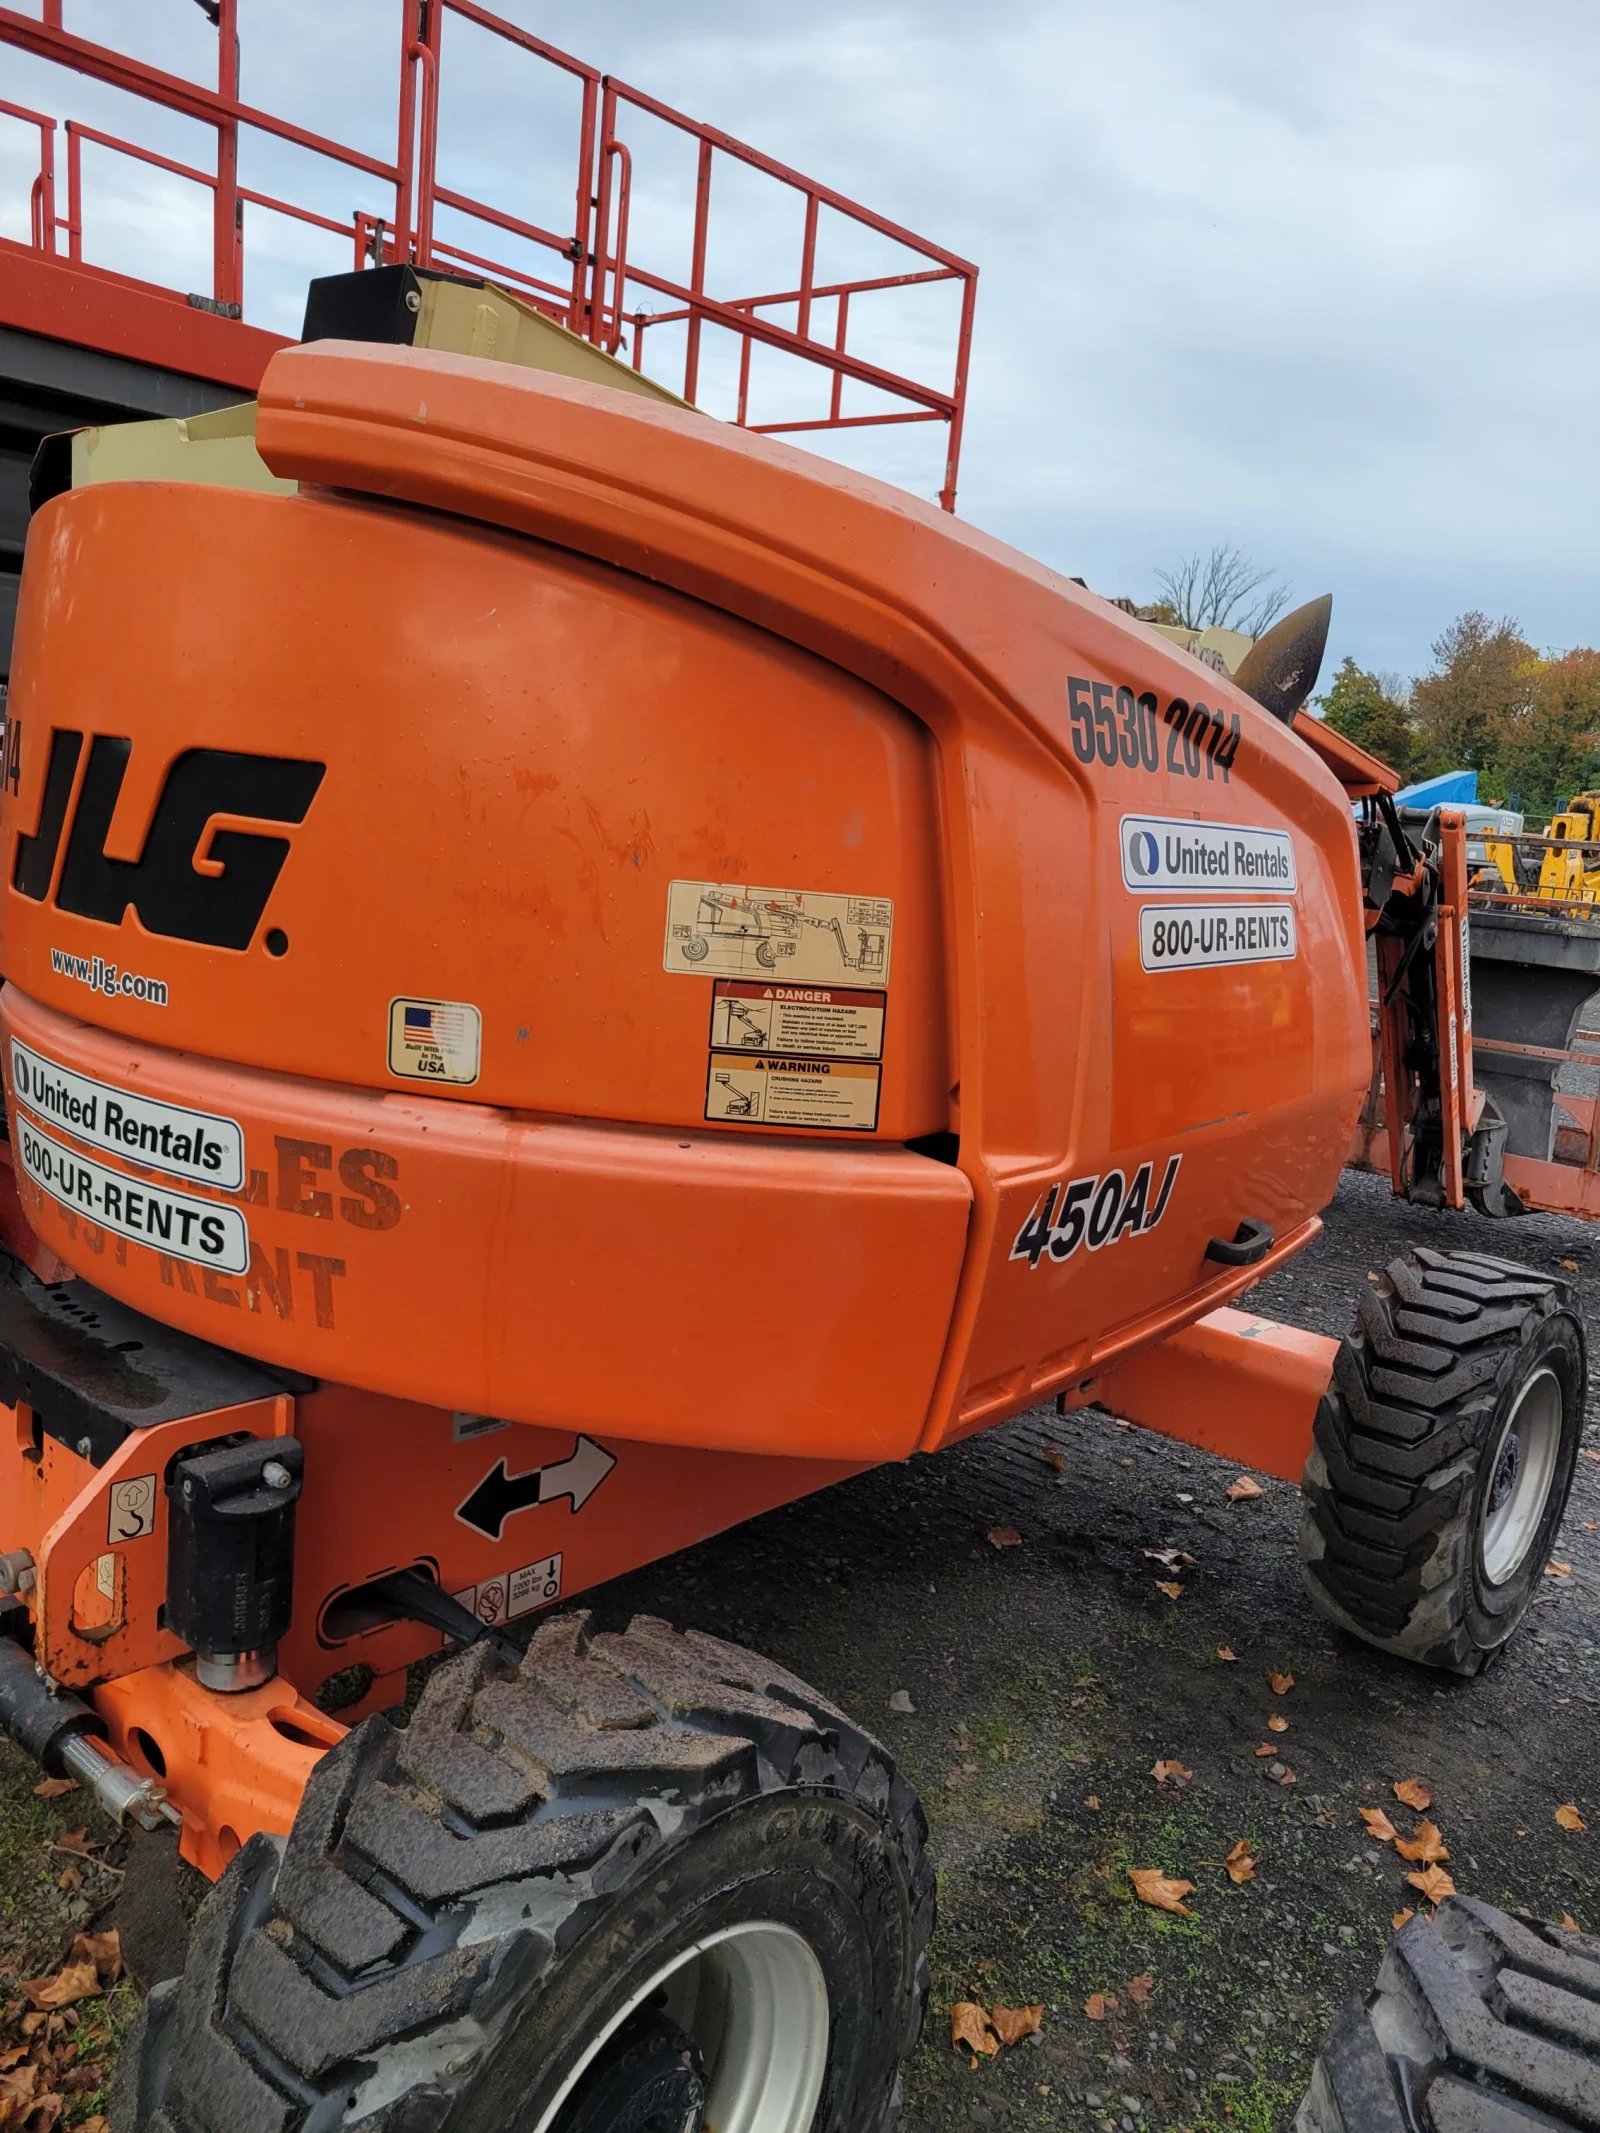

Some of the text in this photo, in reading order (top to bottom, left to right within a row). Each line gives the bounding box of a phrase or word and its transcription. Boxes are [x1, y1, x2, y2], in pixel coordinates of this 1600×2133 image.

[1067, 676, 1241, 784] 5530 2014
[14, 729, 326, 951] JLG
[1166, 836, 1289, 878] United Rentals
[1152, 915, 1289, 957] 800-UR-RENTS
[51, 948, 168, 1005] www.jlg.com
[775, 989, 831, 1003] DANGER
[780, 1005, 831, 1013] ELECTROCUTION
[405, 1043, 422, 1052] Built
[417, 1060, 446, 1075] USA
[430, 1053, 443, 1061] The
[768, 1060, 831, 1074] WARNING
[32, 1065, 223, 1171] United Rentals
[23, 1131, 226, 1255] 800-UR-RENTS
[1010, 1154, 1182, 1267] 450AJ
[519, 1567, 537, 1580] MAX
